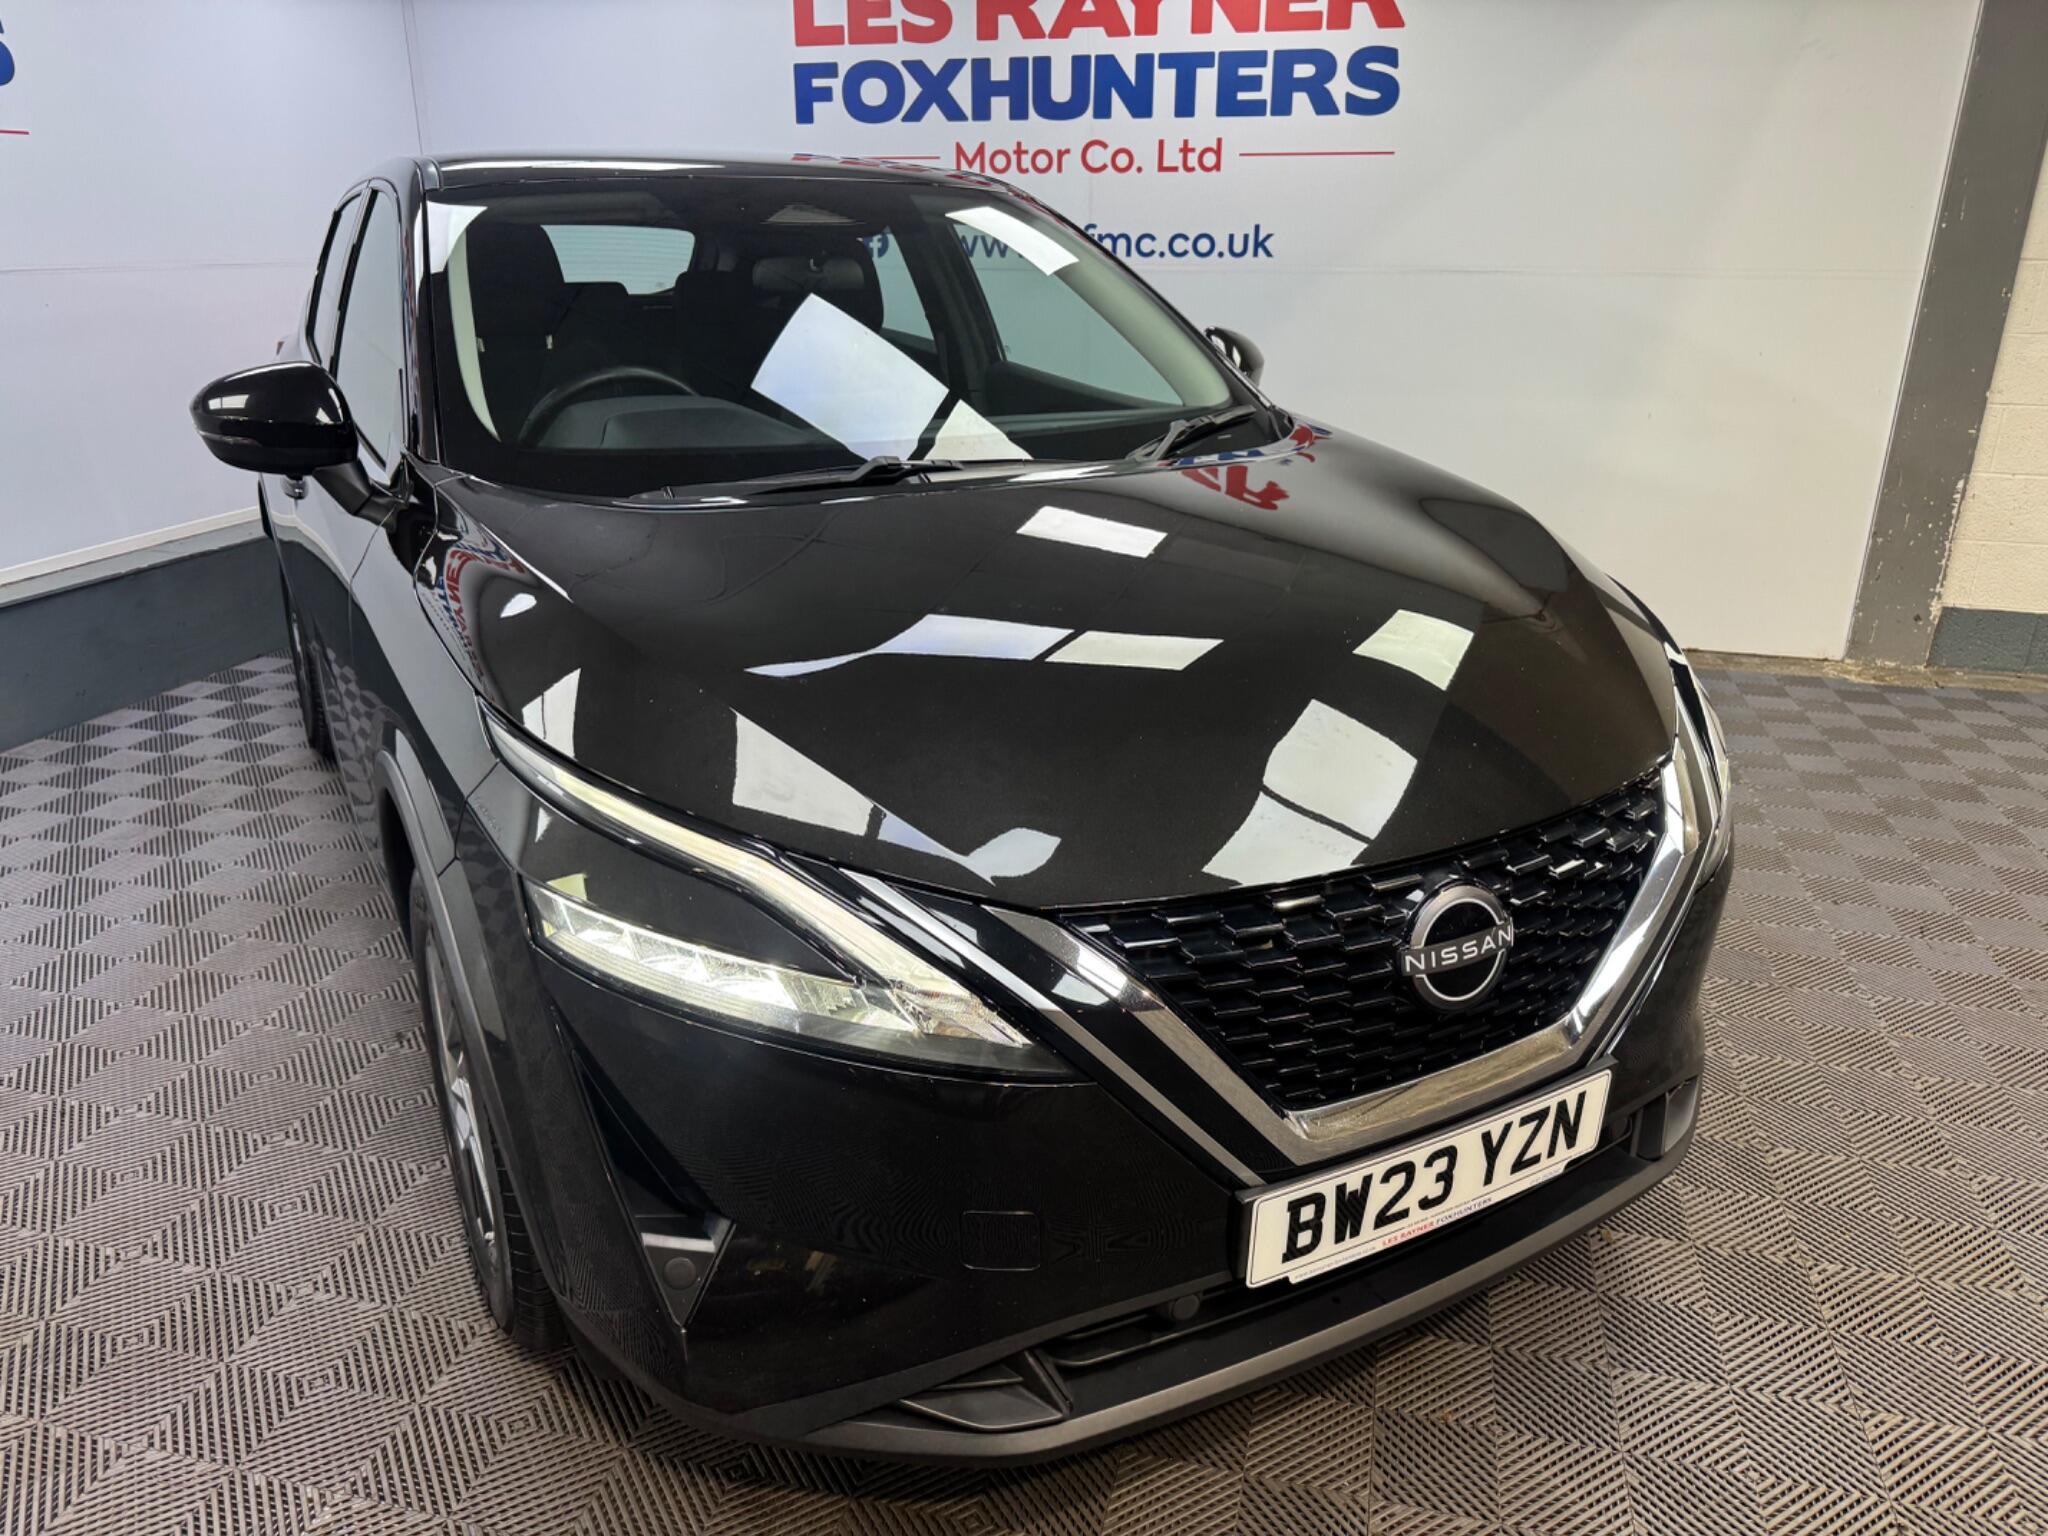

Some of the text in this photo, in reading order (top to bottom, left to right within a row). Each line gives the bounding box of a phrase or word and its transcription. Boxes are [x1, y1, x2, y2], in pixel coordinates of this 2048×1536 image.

[791, 0, 953, 47] LES
[793, 45, 1401, 125] FOXHUNTERS
[954, 140, 1071, 175] Motor
[1080, 138, 1143, 174] Co.
[1156, 137, 1223, 173] Ltd
[1405, 925, 1514, 973] NISSAN
[1281, 1091, 1587, 1264] BW23 YZN
[1400, 1220, 1435, 1239] RAYNER
[1435, 1197, 1493, 1225] FOXHUNTERS
